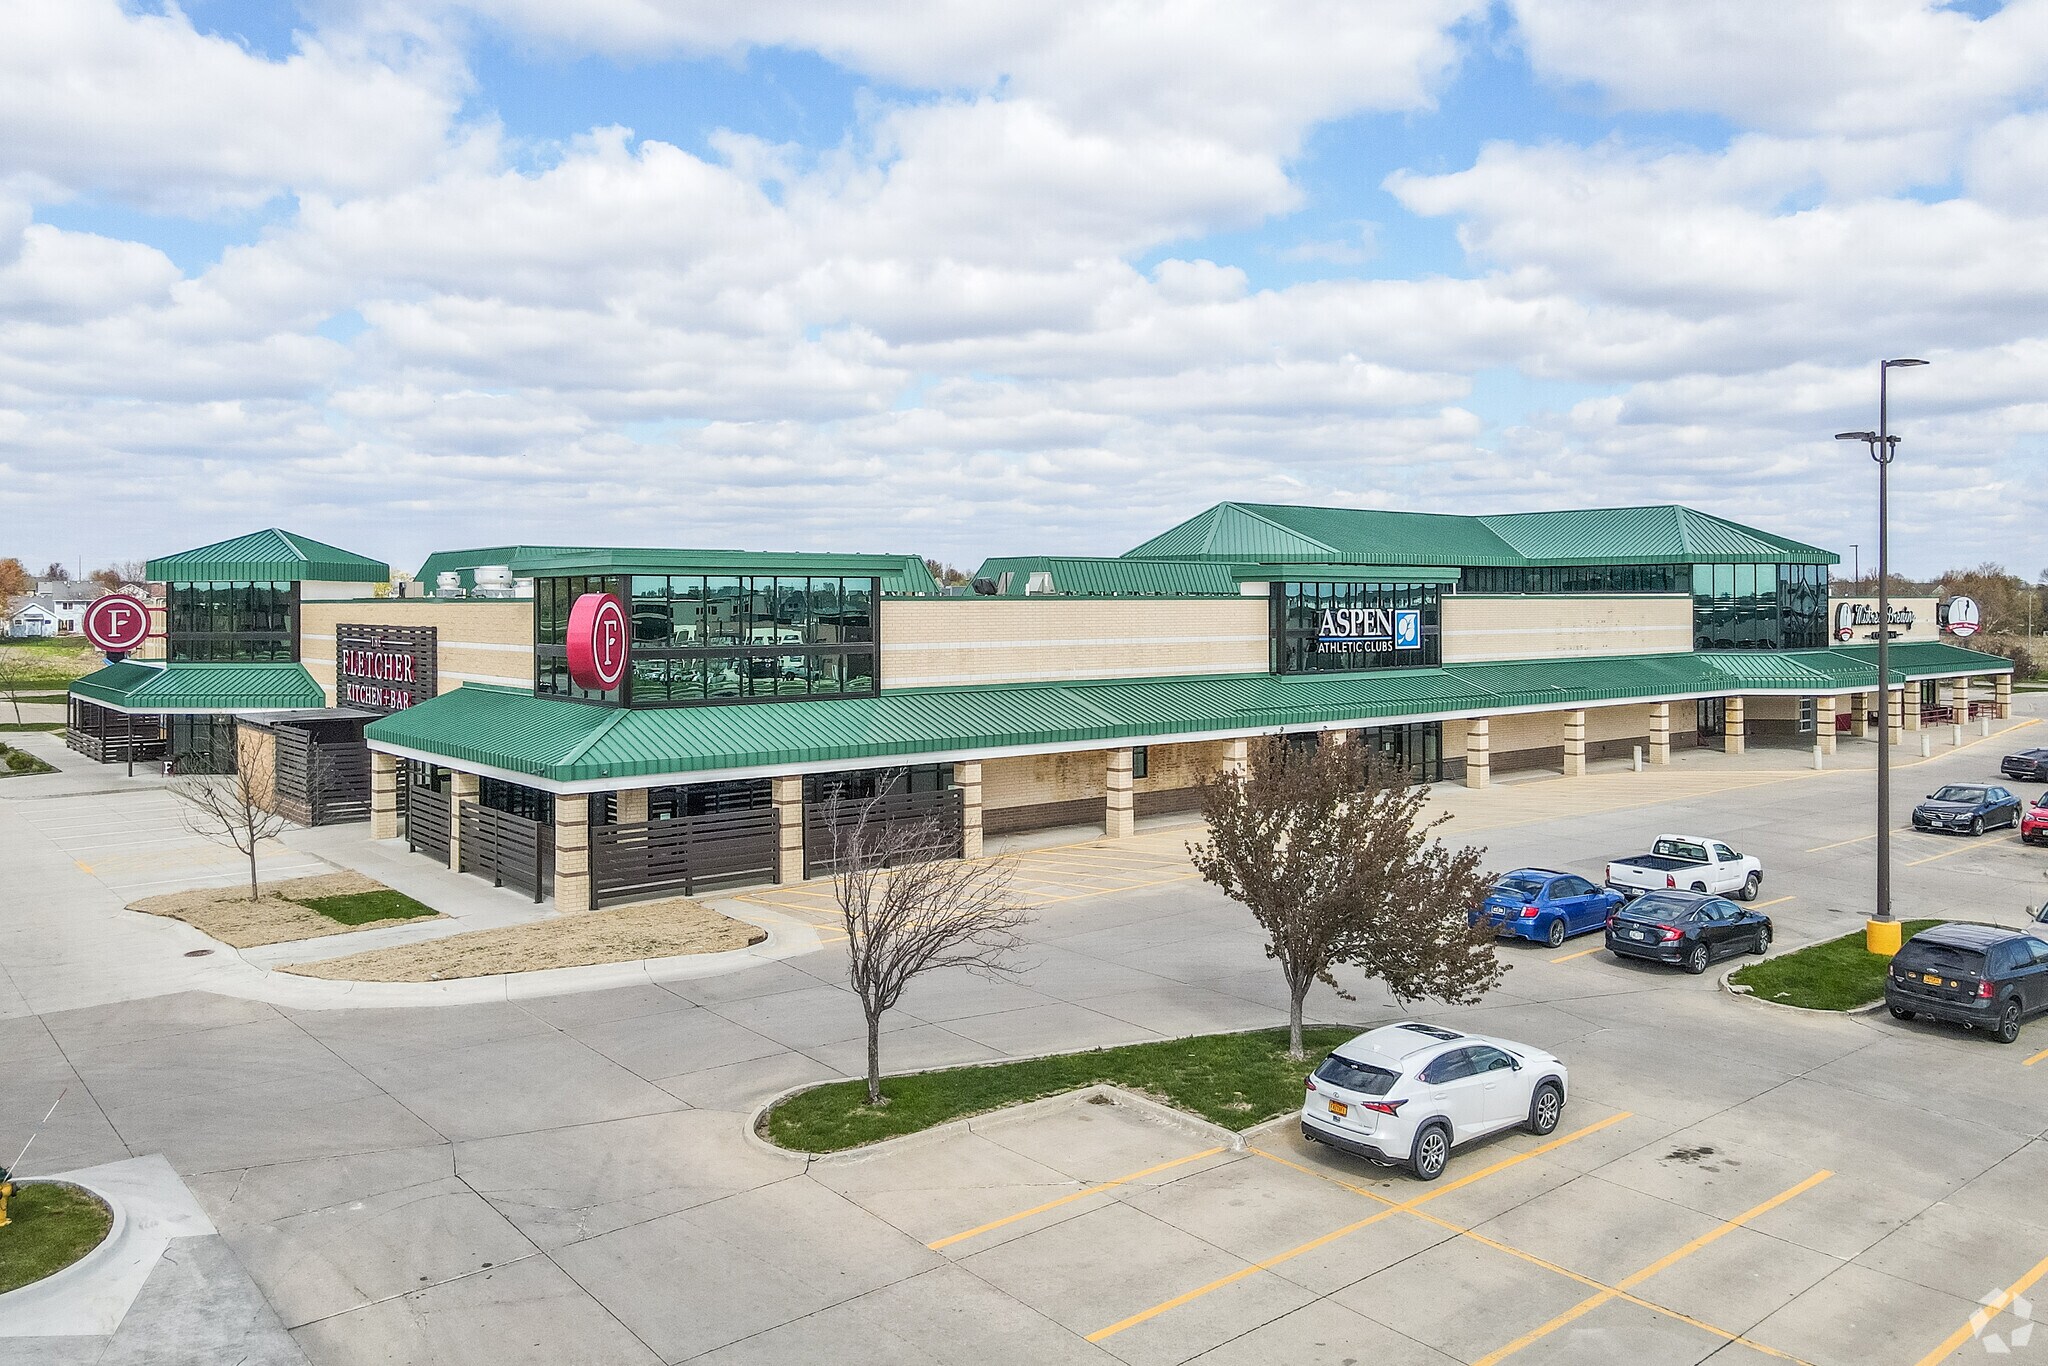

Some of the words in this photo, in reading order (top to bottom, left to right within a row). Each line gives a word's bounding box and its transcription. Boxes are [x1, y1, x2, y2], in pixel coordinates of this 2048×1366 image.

[107, 609, 131, 637] F
[1319, 608, 1394, 637] ASPEN
[603, 620, 617, 666] F
[1317, 641, 1363, 654] ATHLETIC
[1364, 640, 1393, 653] CLUBS
[342, 649, 417, 683] FLETCHER
